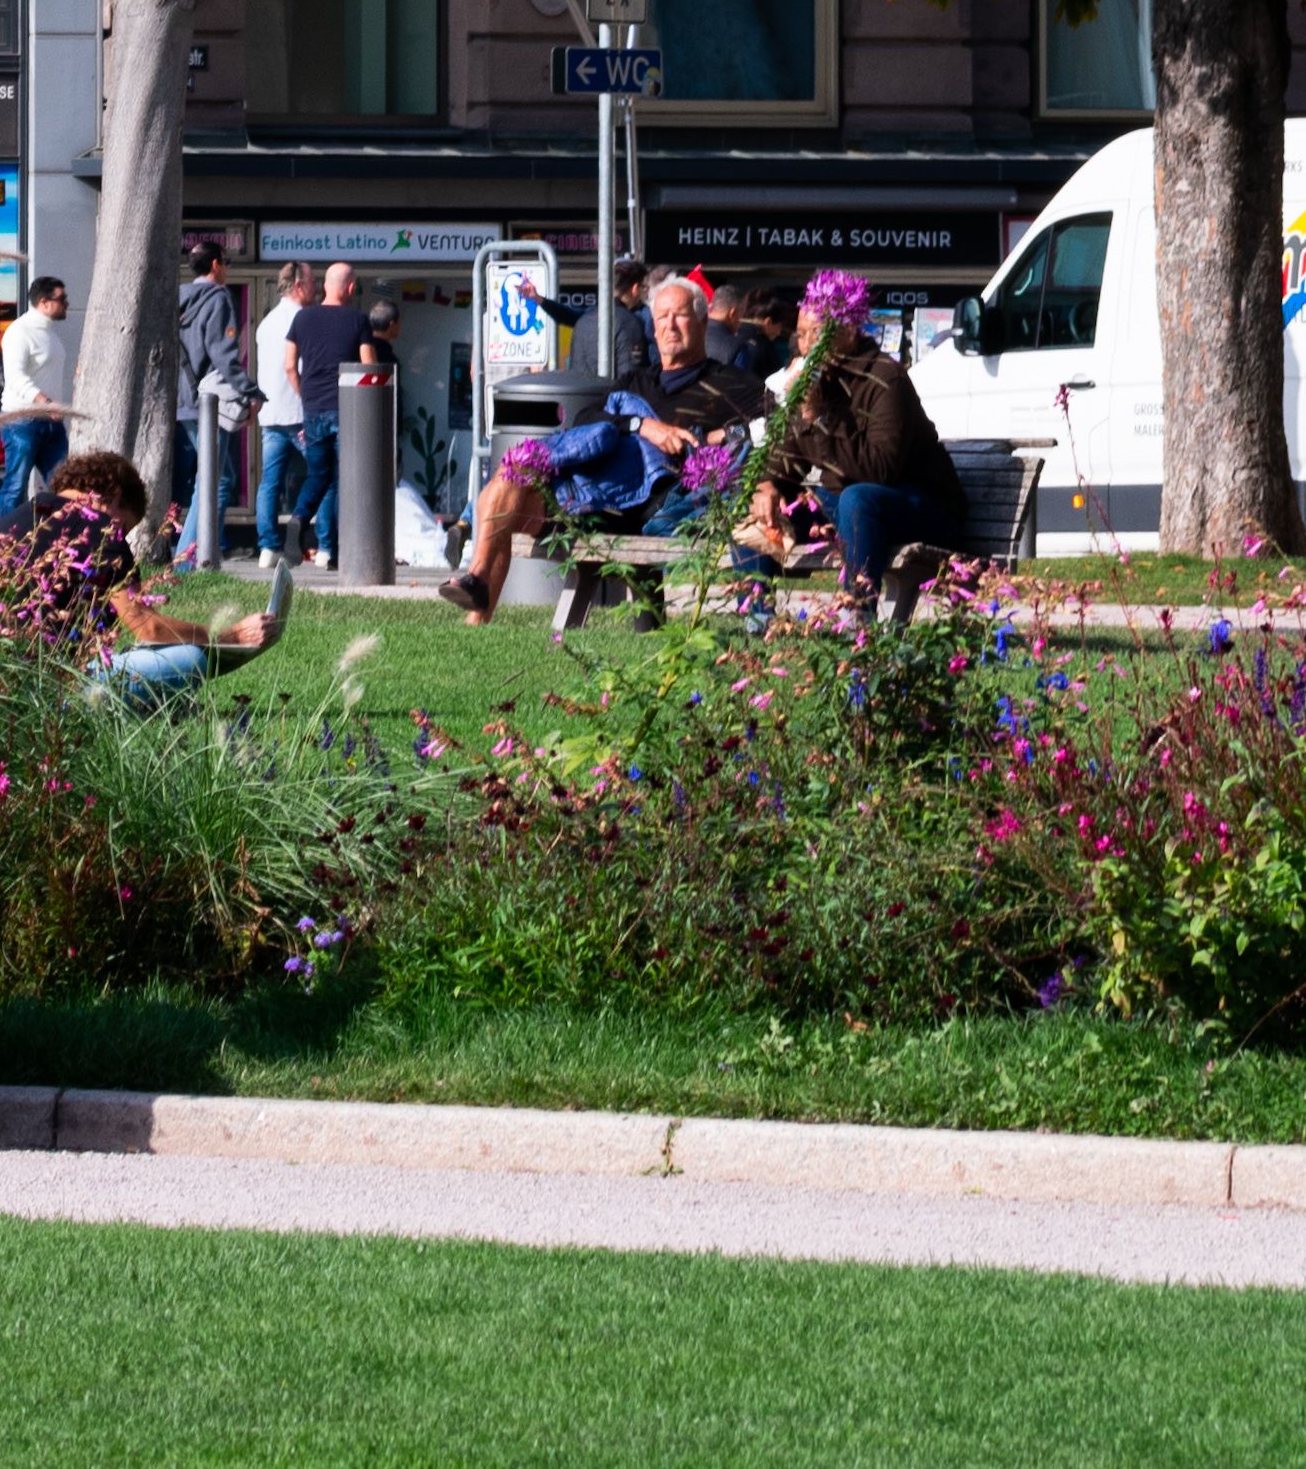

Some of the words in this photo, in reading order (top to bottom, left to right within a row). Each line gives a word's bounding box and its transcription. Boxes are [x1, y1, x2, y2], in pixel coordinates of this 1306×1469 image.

[605, 56, 651, 87] WC
[261, 234, 331, 250] Feinkost
[336, 233, 388, 250] Latino
[678, 227, 739, 245] HEINZ
[758, 227, 824, 246] TABAK
[830, 229, 844, 246] &
[849, 230, 952, 248] SOUVENIR
[886, 291, 929, 305] IQOS
[502, 341, 533, 358] ZONE
